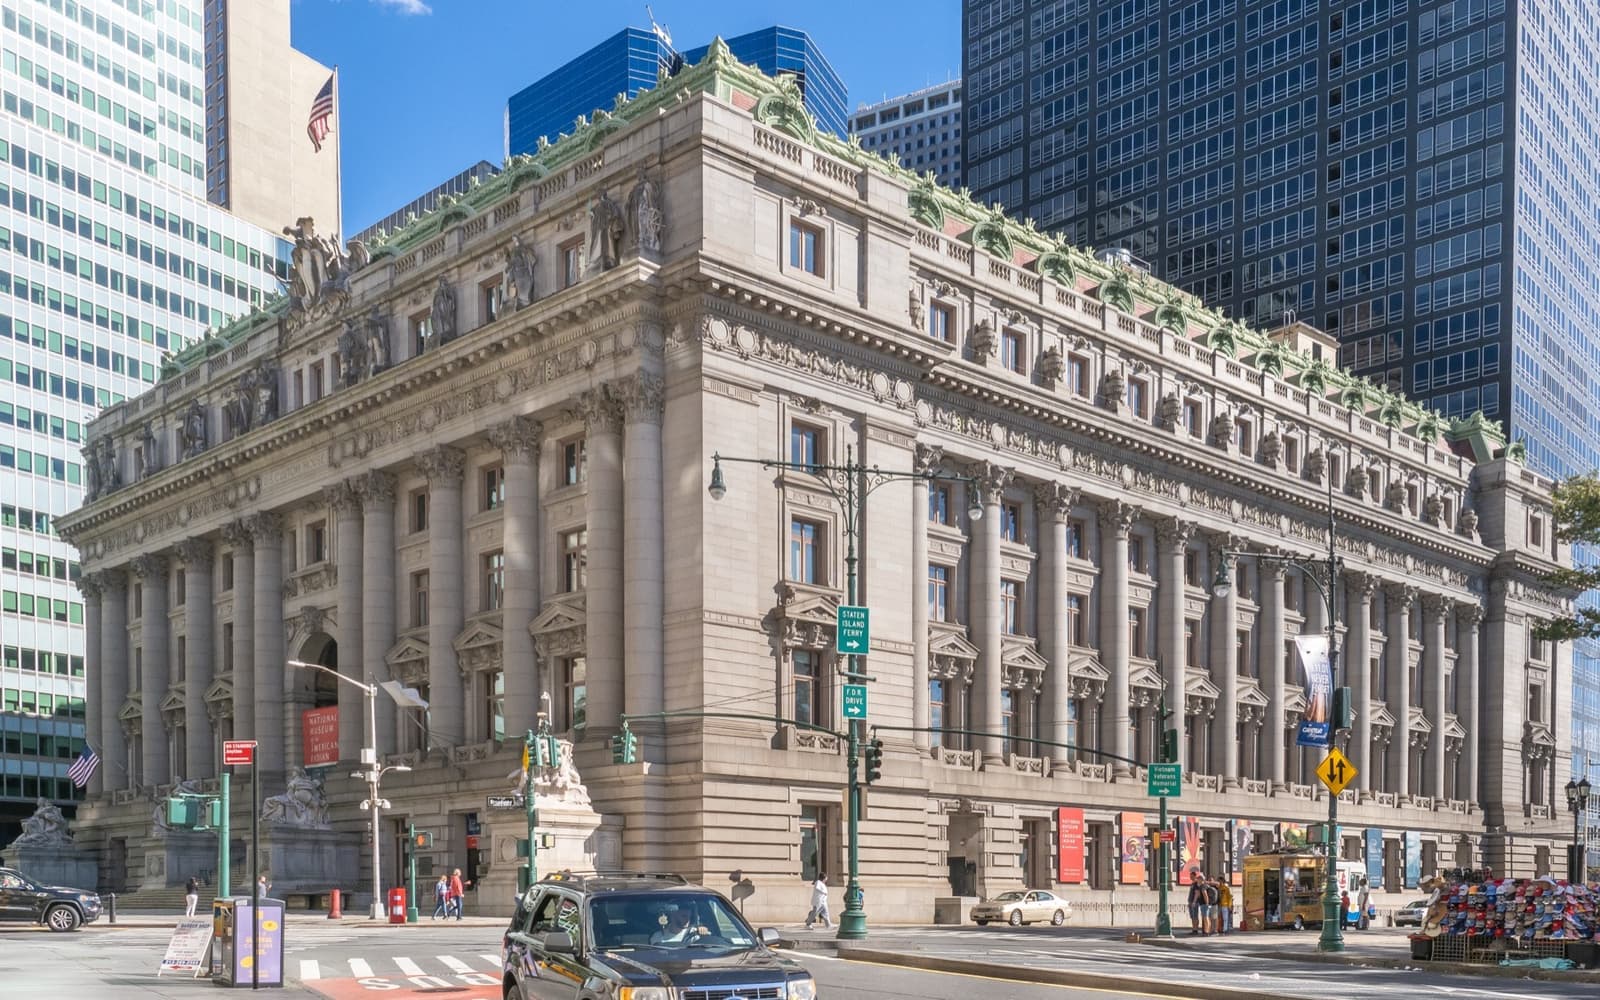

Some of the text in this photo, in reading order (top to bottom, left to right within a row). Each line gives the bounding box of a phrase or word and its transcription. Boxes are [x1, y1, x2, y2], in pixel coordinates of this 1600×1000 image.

[842, 610, 865, 619] STATEN
[842, 619, 865, 628] ISLAND
[843, 628, 863, 637] FERRY
[845, 696, 864, 704] DRIVE
[309, 713, 337, 725] NATIONAL
[310, 723, 334, 735] MUSEUM
[311, 741, 338, 752] AMERICAN
[357, 973, 503, 990] BUS
